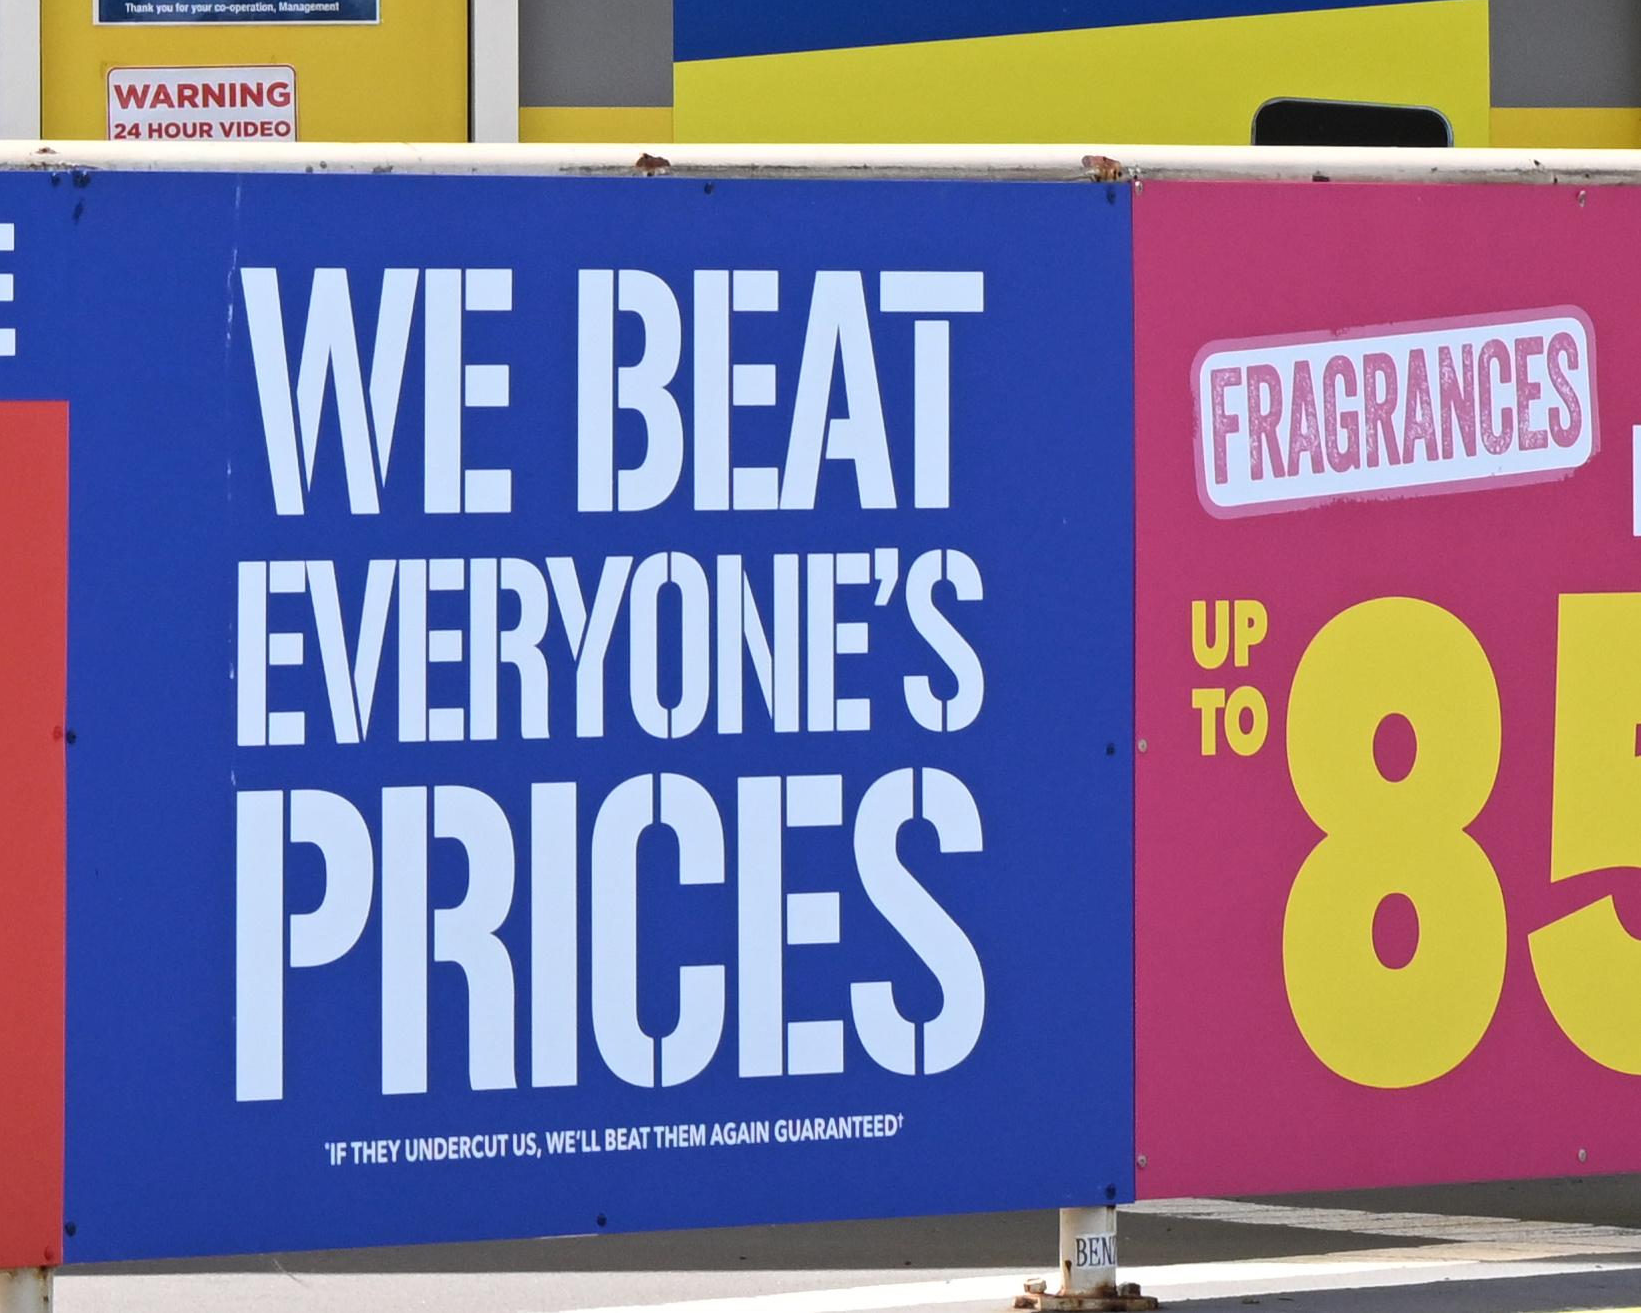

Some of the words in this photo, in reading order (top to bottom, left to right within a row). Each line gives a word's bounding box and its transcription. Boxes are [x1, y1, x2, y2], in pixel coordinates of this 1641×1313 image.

[125, 2, 153, 13] Thank
[156, 5, 173, 14] you
[176, 3, 188, 12] for
[191, 4, 212, 14] your
[279, 2, 339, 13] Management
[114, 82, 291, 110] WARNING
[114, 122, 142, 140] 24
[148, 121, 213, 139] HOUR
[219, 120, 291, 139] VIDEO
[239, 266, 514, 517] WE
[577, 268, 986, 514] BEAT
[1209, 328, 1585, 486] FRAGRANCES
[236, 547, 986, 748] EVERYONE'S
[1190, 598, 1269, 671] UP
[1190, 686, 1269, 758] TO
[234, 767, 987, 1104] PRICES
[350, 1139, 401, 1164] THEY
[404, 1133, 508, 1162] UNDERCUT
[512, 1132, 542, 1159] US,
[545, 1127, 601, 1155] WE'LL
[604, 1126, 649, 1152] BEAT
[653, 1123, 706, 1149] THEM
[709, 1120, 771, 1146] AGAIN
[1075, 1235, 1117, 1267] BEN
